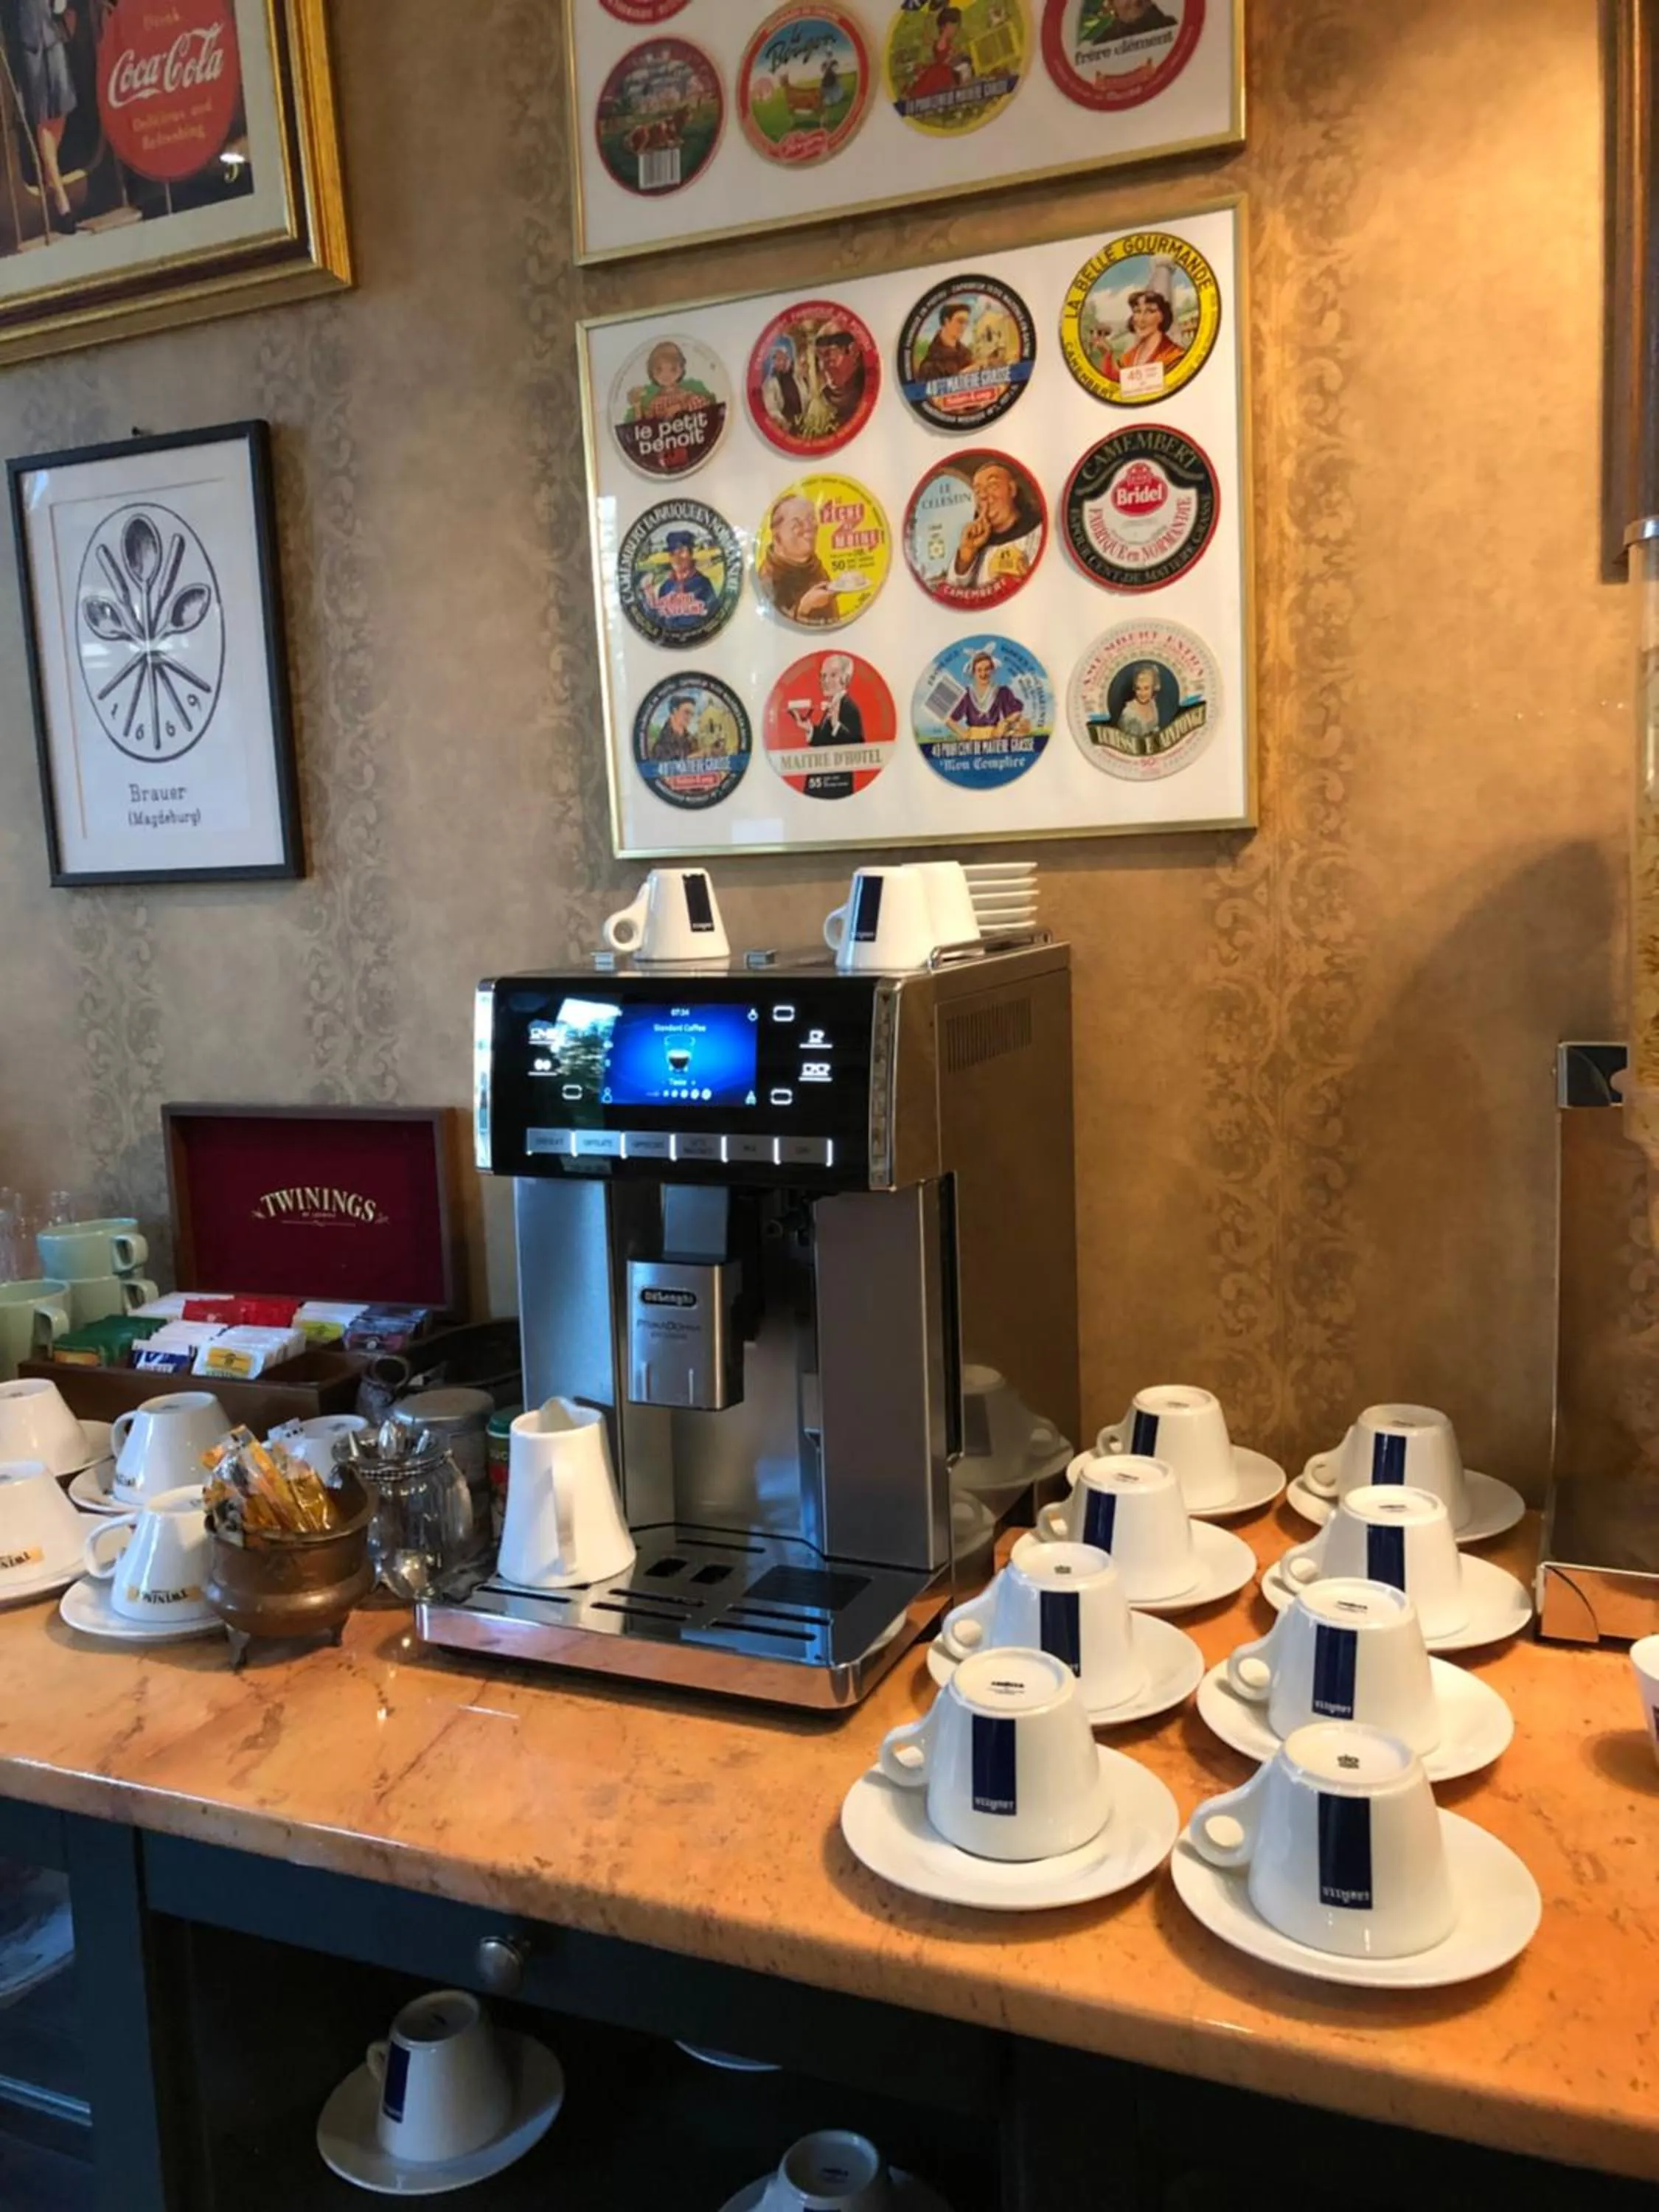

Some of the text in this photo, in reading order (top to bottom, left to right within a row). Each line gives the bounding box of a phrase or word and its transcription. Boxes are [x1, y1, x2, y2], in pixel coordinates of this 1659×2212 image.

[1065, 299, 1081, 319] LA
[1077, 246, 1116, 290] BELLE
[1123, 235, 1215, 291] GOURMANDE
[634, 412, 708, 440] le petit
[639, 428, 705, 455] benoit
[1081, 432, 1198, 480] CAMEMBERT
[939, 484, 950, 493] LE
[1116, 484, 1163, 506] Bridel
[128, 783, 187, 802] Brauer
[128, 807, 201, 828] (Magdeburg)
[684, 1023, 706, 1032] Coffee
[260, 1186, 377, 1222] TWININGS
